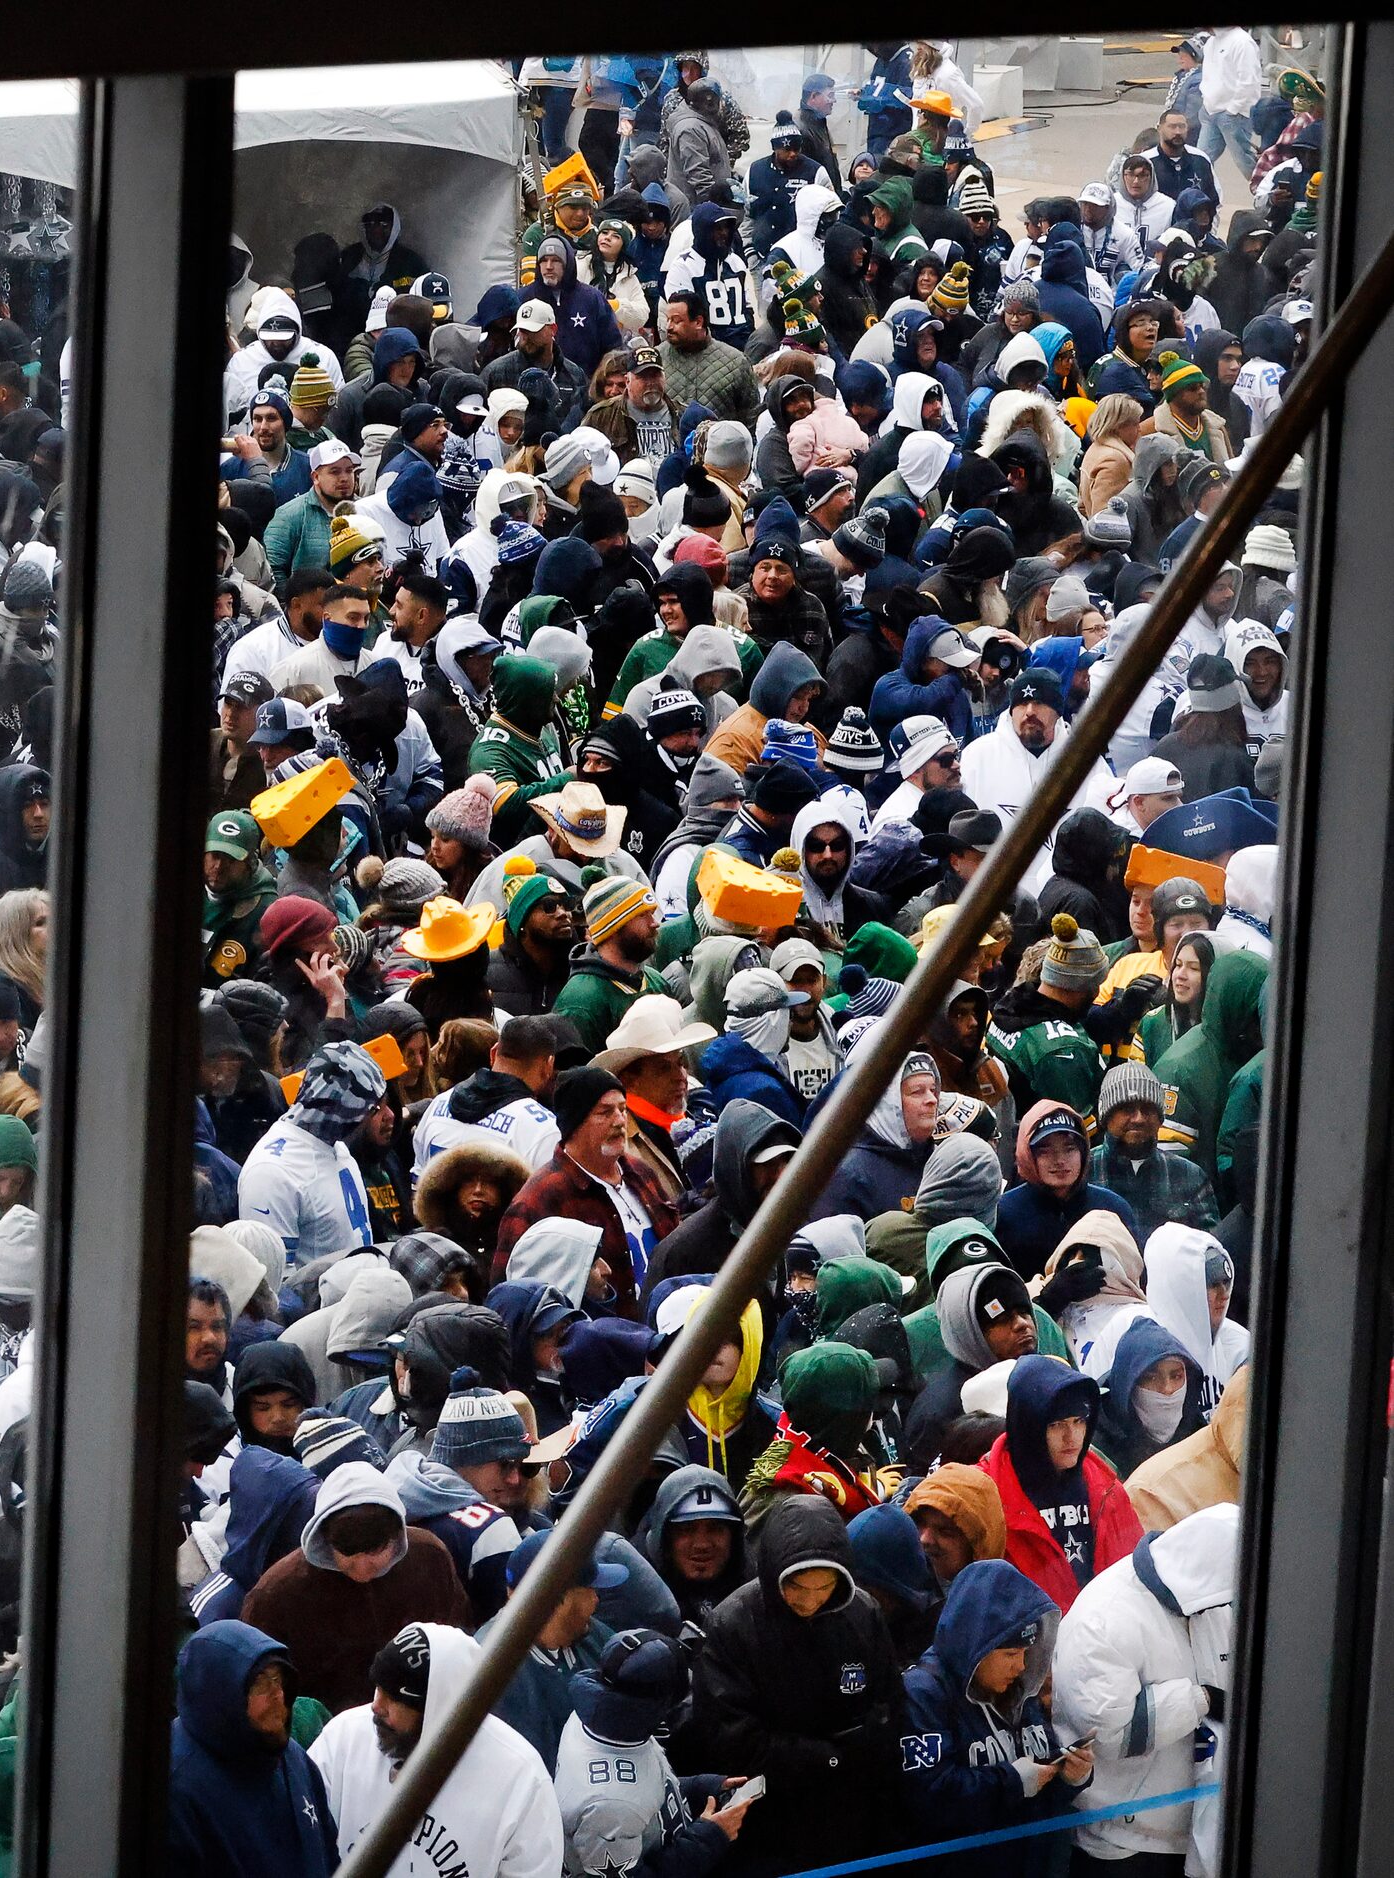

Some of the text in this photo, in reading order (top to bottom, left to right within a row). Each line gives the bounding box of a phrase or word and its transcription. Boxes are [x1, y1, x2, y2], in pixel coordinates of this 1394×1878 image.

[705, 278, 747, 325] 87
[1182, 823, 1216, 837] COWBOYS
[1041, 1019, 1079, 1041] 12
[588, 1758, 638, 1785] 88
